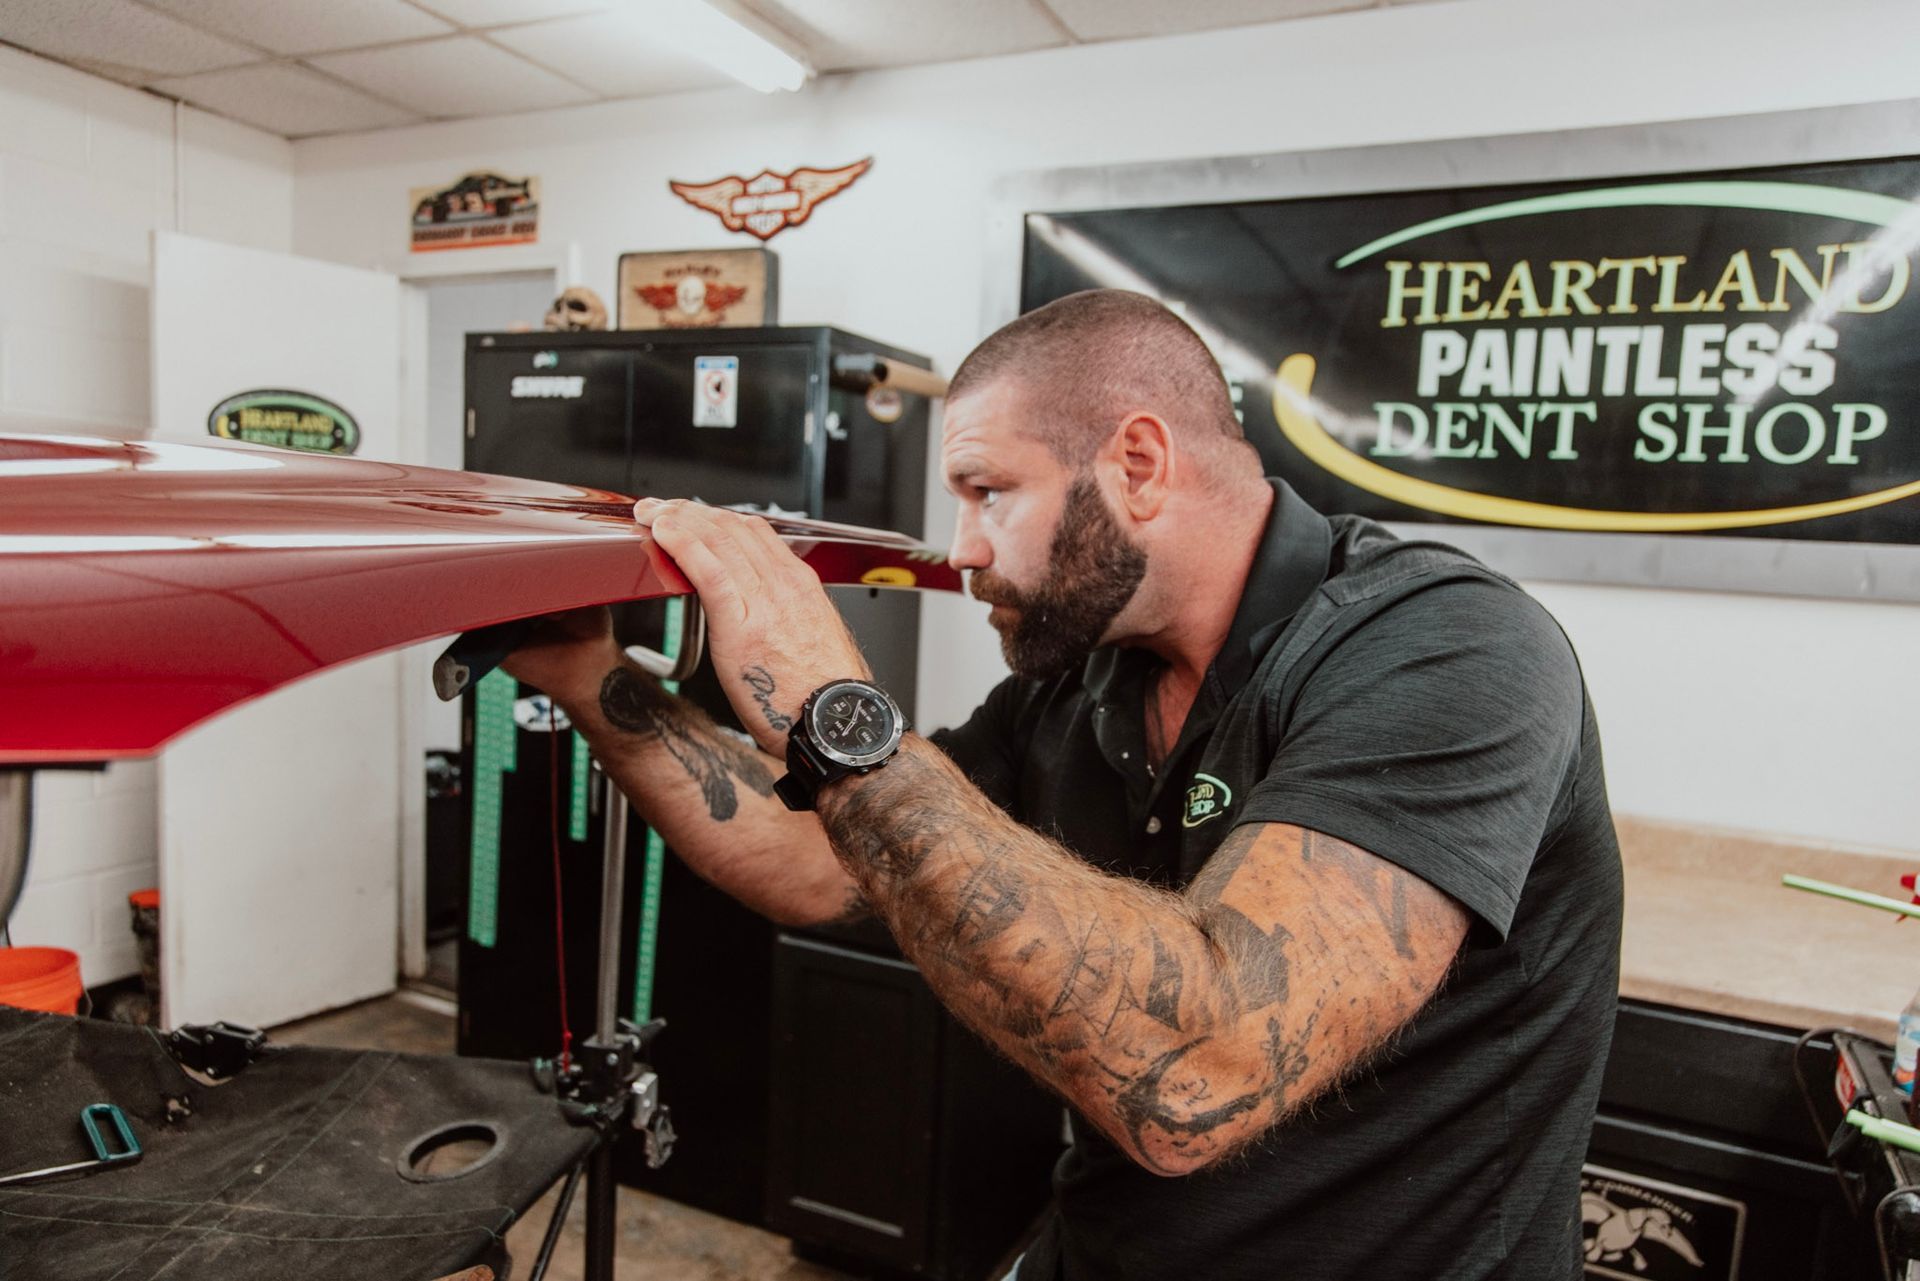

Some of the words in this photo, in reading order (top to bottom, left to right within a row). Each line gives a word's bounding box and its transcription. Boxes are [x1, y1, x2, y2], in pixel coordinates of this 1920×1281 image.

[1380, 240, 1911, 328] HEARTLAND
[1417, 321, 1839, 397] PAINTLESS
[1370, 401, 1598, 460] DENT
[1634, 401, 1889, 465] SHOP
